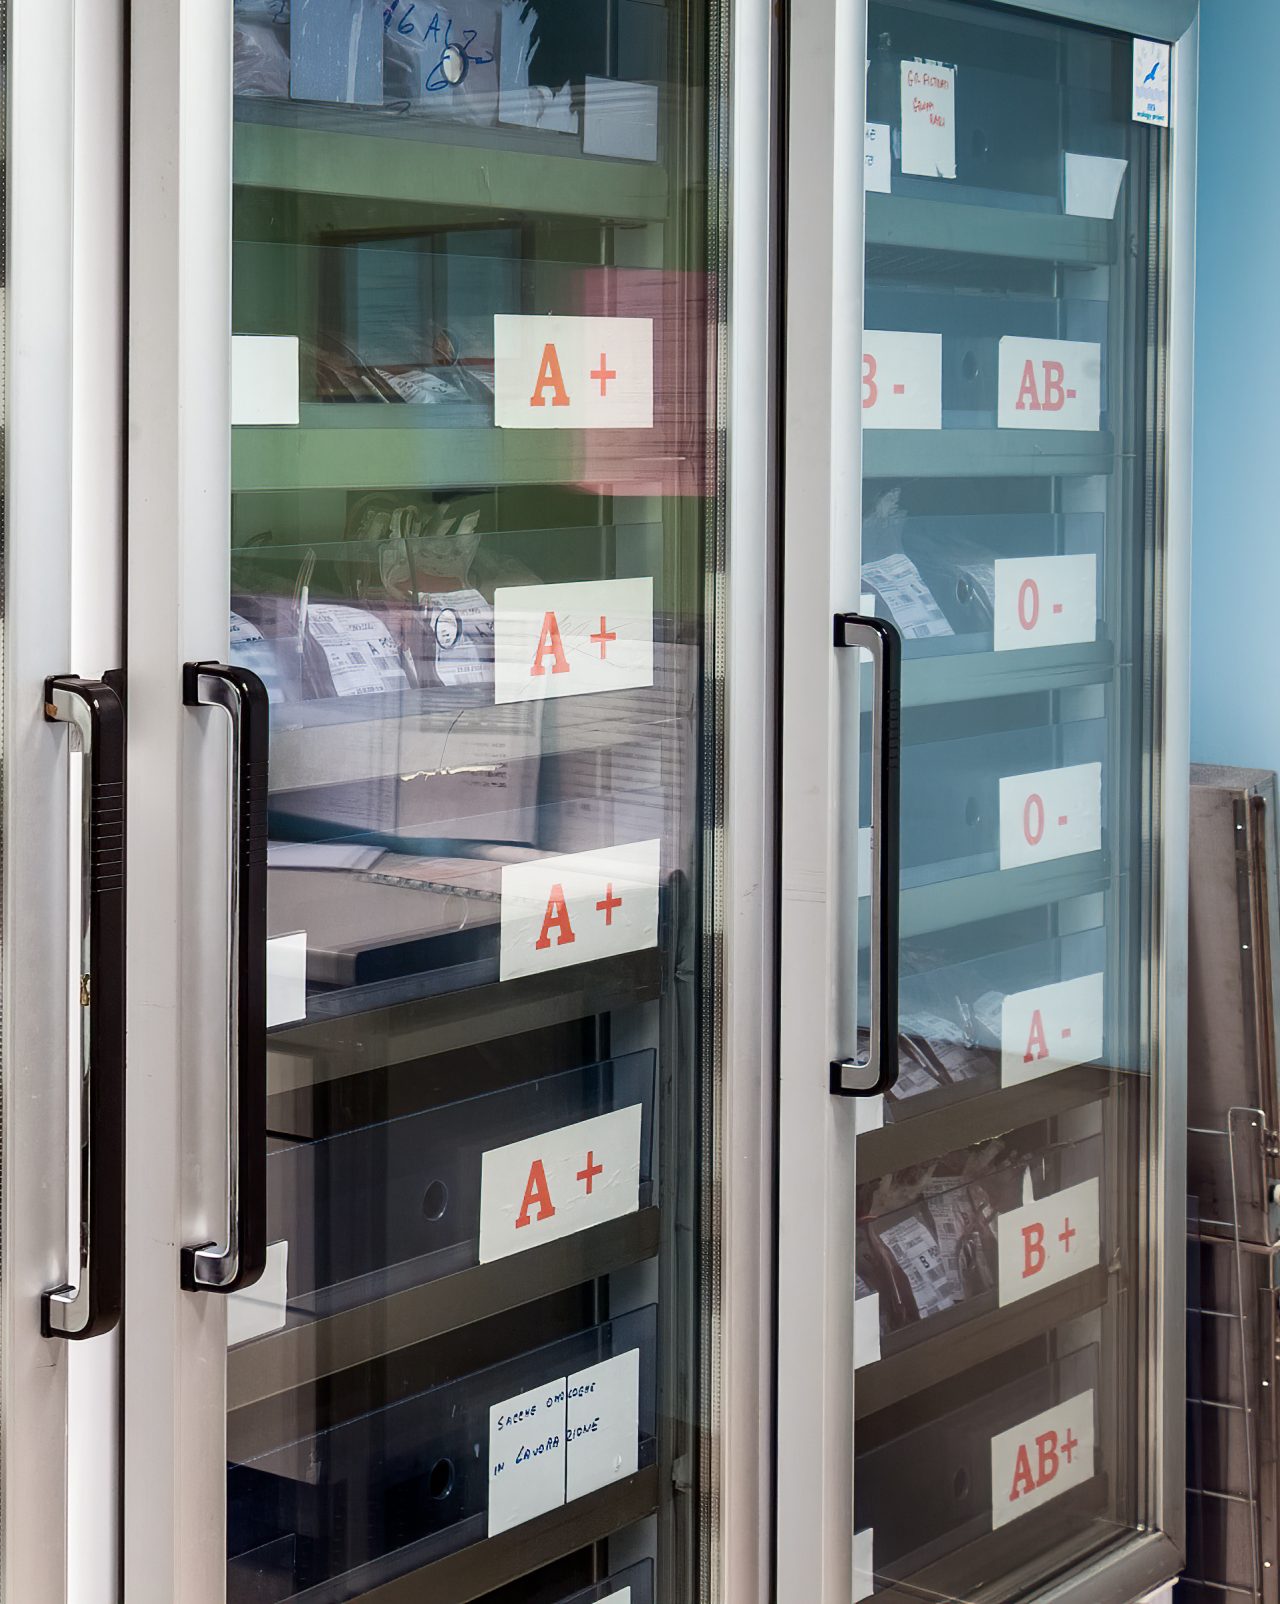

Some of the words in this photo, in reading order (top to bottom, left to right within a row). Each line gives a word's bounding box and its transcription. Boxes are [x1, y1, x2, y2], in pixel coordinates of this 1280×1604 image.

[530, 343, 570, 407] A
[590, 353, 617, 397] +
[1015, 359, 1076, 411] AB-
[530, 611, 570, 677] A
[590, 615, 617, 660] +
[535, 884, 575, 950] A
[596, 882, 622, 926] +
[1023, 1009, 1049, 1064] A
[515, 1159, 555, 1229] A
[577, 1151, 603, 1194] +
[1022, 1222, 1046, 1279] B
[1058, 1217, 1076, 1253] +
[493, 1462, 505, 1476] IN
[1009, 1428, 1078, 1502] AB+
